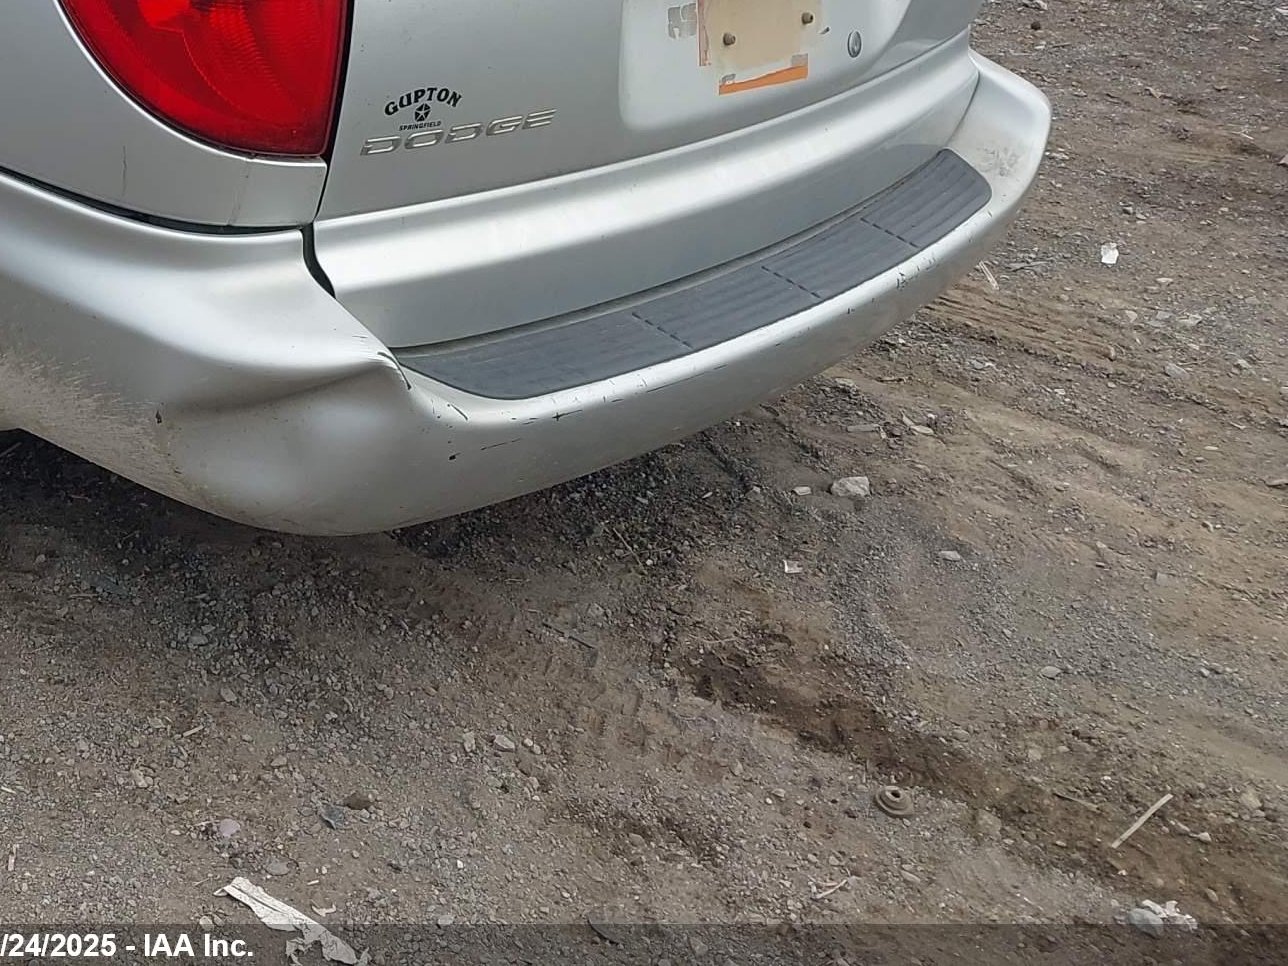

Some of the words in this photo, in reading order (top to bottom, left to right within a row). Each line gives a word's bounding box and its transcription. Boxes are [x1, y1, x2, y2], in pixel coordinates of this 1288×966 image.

[384, 87, 462, 116] GUPTON
[360, 109, 557, 155] DODGE
[399, 121, 441, 131] SPRINGFIELD
